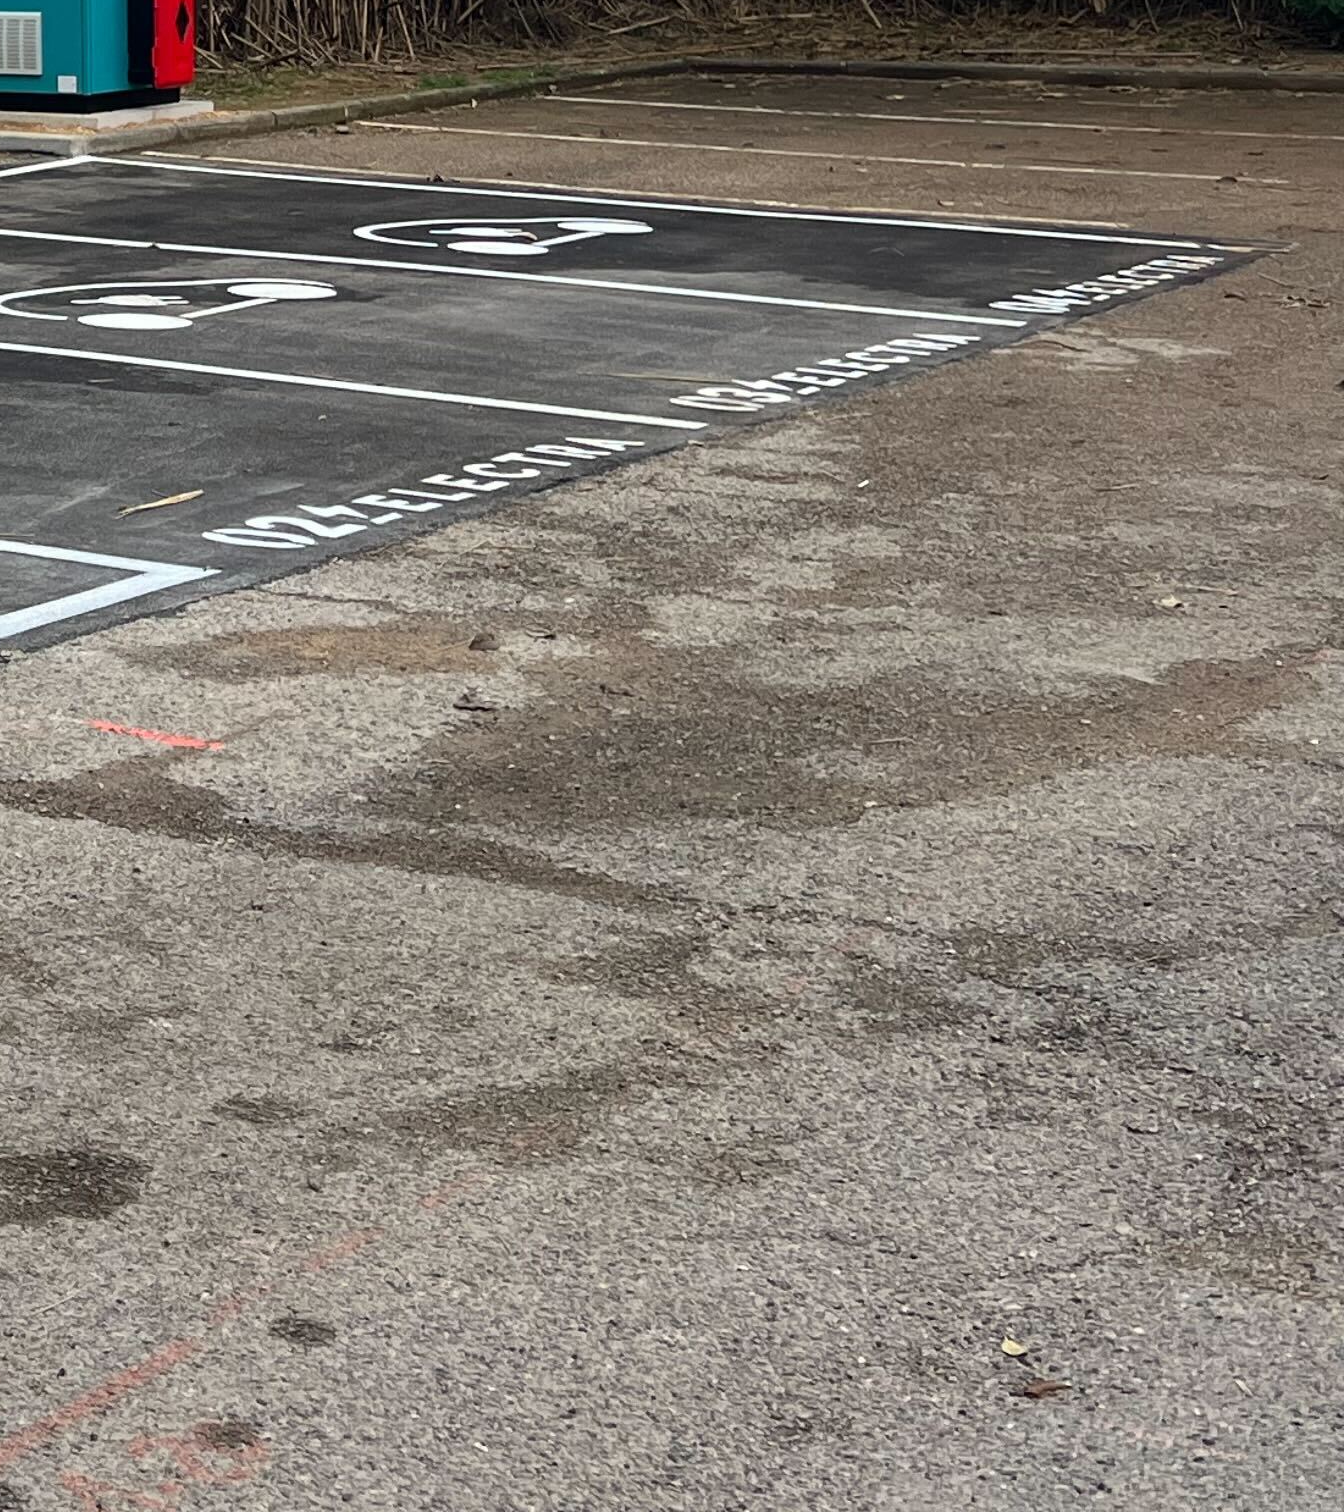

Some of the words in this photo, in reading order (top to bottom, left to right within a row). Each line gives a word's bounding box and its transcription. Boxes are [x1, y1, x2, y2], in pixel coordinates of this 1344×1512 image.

[1065, 255, 1225, 294] ELECTRA
[669, 387, 792, 412] 03
[771, 333, 981, 387] ELECTRA
[201, 515, 369, 549] 02
[352, 436, 646, 513] ELECTRA
